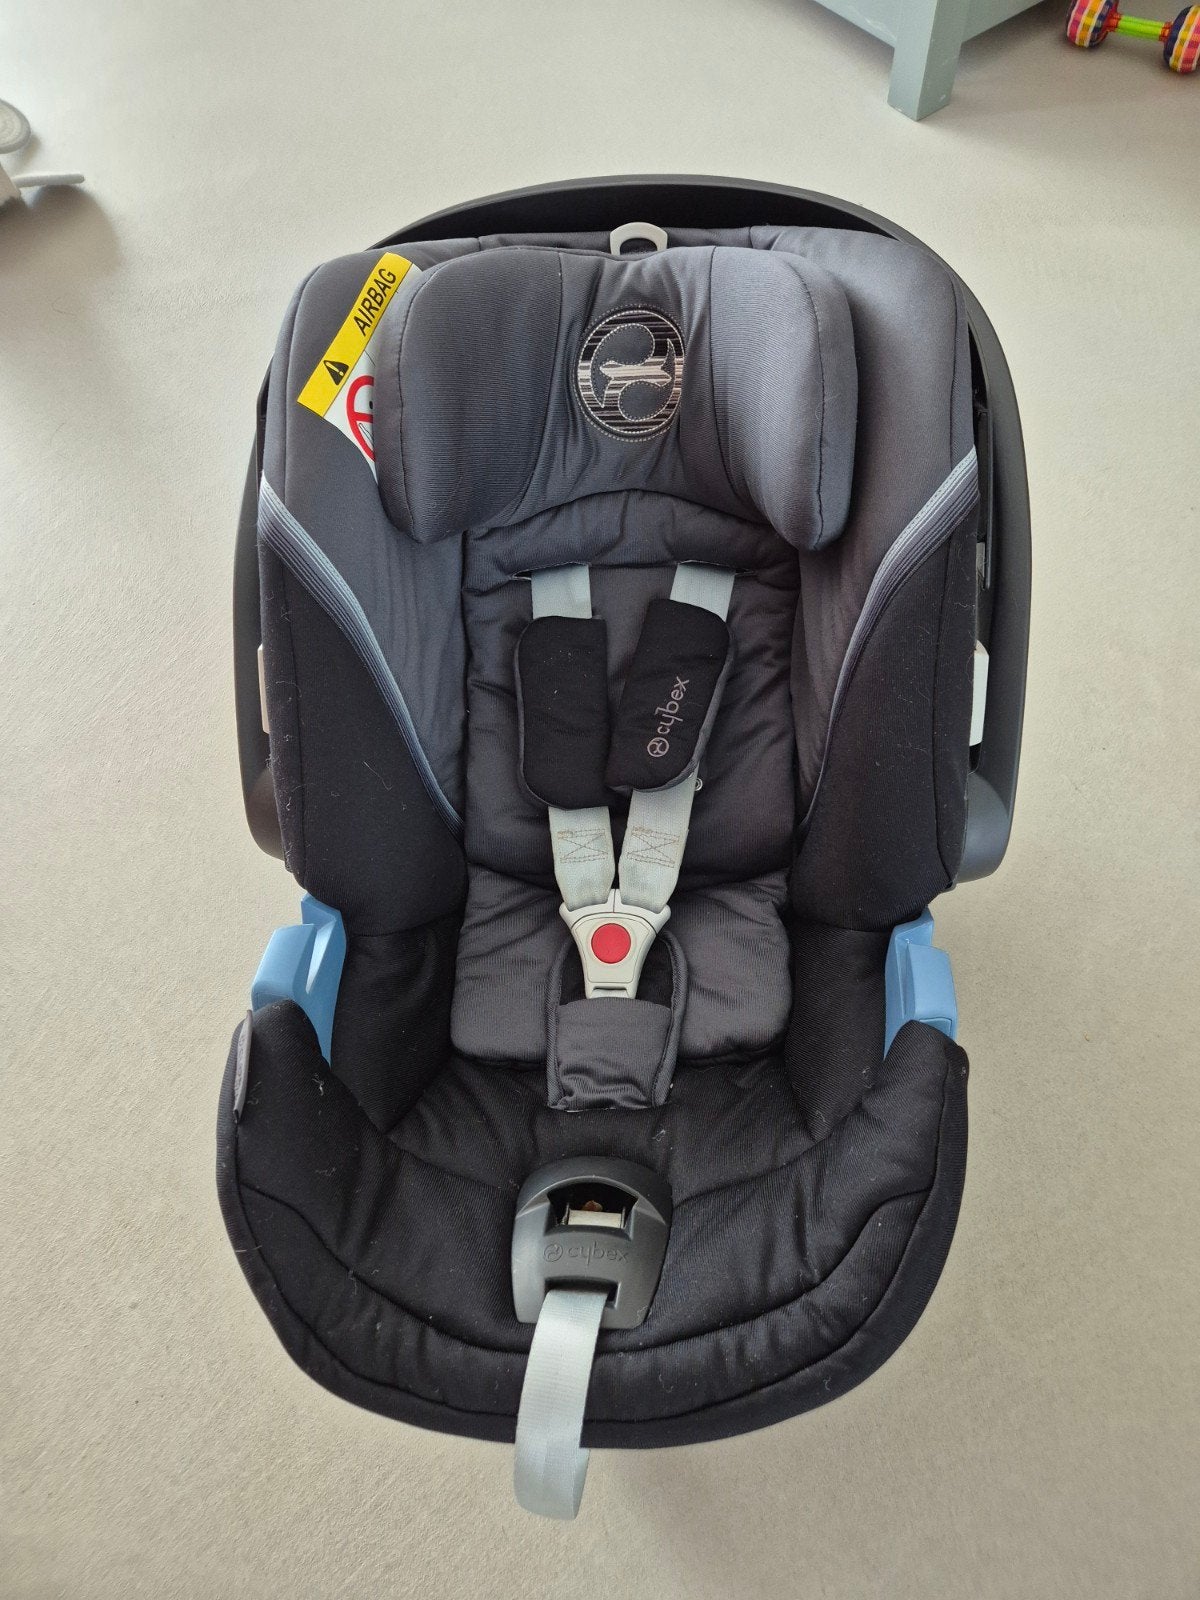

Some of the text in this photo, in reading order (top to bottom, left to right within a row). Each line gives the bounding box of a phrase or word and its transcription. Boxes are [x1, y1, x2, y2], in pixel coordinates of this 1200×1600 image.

[353, 268, 396, 336] AIRBAG
[655, 676, 690, 734] cybex
[568, 1240, 629, 1264] cybex
